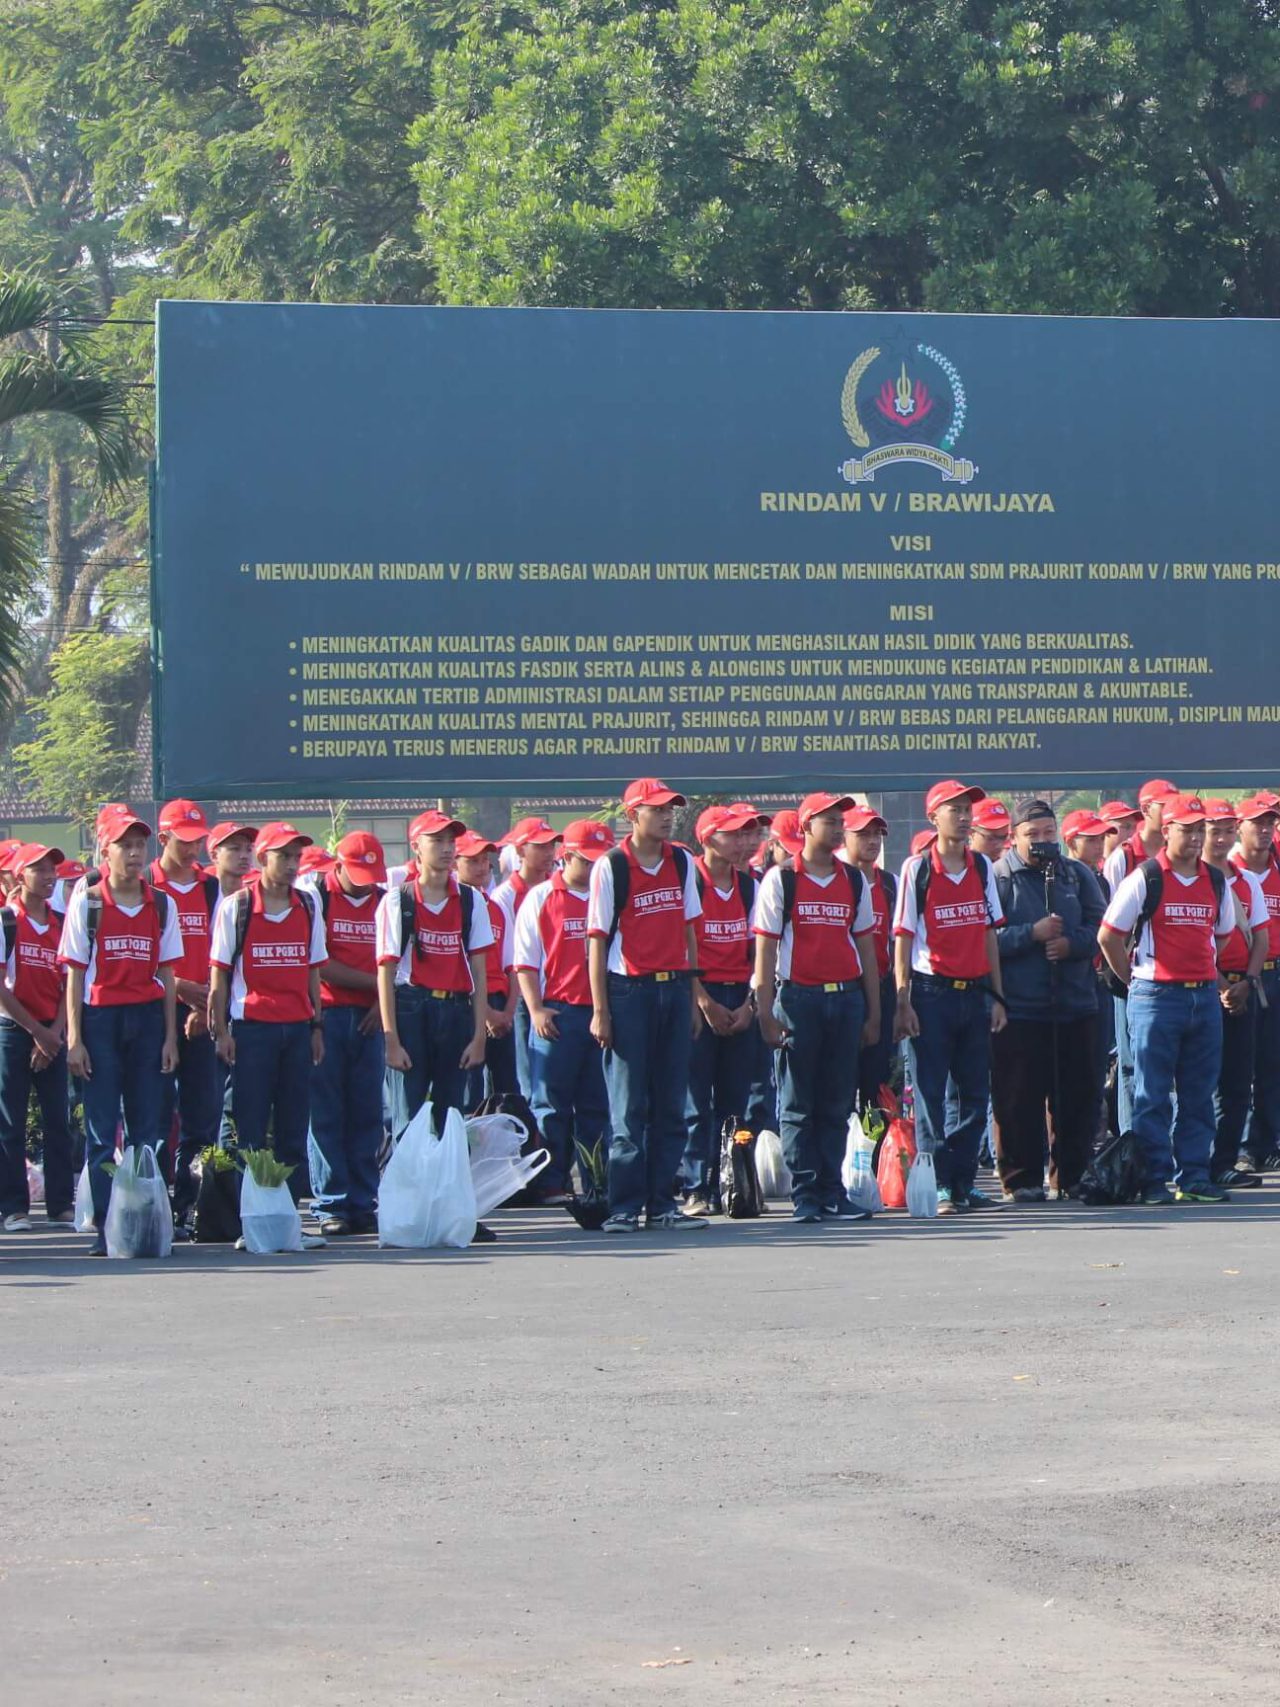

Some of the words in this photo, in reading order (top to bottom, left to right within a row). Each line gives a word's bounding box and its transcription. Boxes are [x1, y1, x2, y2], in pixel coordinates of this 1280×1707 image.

[760, 493, 862, 511] RINDAM
[868, 493, 888, 511] V
[894, 493, 902, 512] /
[908, 493, 1056, 512] BRAWIJAYA
[889, 536, 932, 551] VISI
[255, 563, 374, 580] MEWUJUDKAN
[378, 563, 445, 580] RINDAM
[448, 563, 461, 579] V
[464, 563, 472, 580] /
[475, 563, 515, 579] BRW
[518, 563, 588, 580] SEBAGAI
[591, 564, 651, 580] WADAH
[655, 563, 710, 579] UNTUK
[713, 563, 801, 579] MENCETAK
[805, 563, 838, 579] DAN
[841, 563, 965, 579] MENINGKATKAN
[969, 563, 1005, 579] SDM
[1008, 563, 1085, 579] PRAJURIT
[1088, 564, 1144, 579] KODAM
[1147, 564, 1159, 579] V
[1162, 563, 1169, 579] /
[1172, 564, 1208, 579] BRW
[1211, 564, 1252, 579] YANG
[889, 605, 934, 620] MISI
[302, 636, 433, 653] MENINGKATKAN
[437, 636, 516, 652] KUALITAS
[520, 636, 571, 652] GADIK
[574, 636, 608, 652] DAN
[612, 635, 694, 652] GAPENDIK
[698, 635, 752, 651] UNTUK
[755, 634, 880, 651] MENGHASILKAN
[884, 634, 930, 650] HASIL
[933, 634, 977, 649] DIDIK
[980, 634, 1022, 649] YANG
[1026, 633, 1134, 649] BERKUALITAS.
[302, 662, 433, 679] MENINGKATKAN
[437, 662, 516, 678] KUALITAS
[520, 662, 579, 677] FASDIK
[584, 661, 635, 677] SERTA
[638, 661, 686, 677] ALINS
[690, 661, 703, 677] &
[707, 660, 786, 676] ALONGINS
[790, 660, 843, 675] UNTUK
[847, 659, 947, 675] MENDUKUNG
[951, 659, 1027, 674] KEGIATAN
[1031, 658, 1124, 674] PENDIDIKAN
[1128, 658, 1140, 673] &
[1144, 658, 1214, 673] LATIHAN.
[302, 688, 418, 705] MENEGAKKAN
[421, 688, 480, 704] TERTIB
[484, 687, 602, 703] ADMINISTRASI
[606, 687, 664, 703] DALAM
[668, 686, 725, 702] SETIAP
[730, 685, 837, 701] PENGGUNAAN
[841, 685, 927, 700] ANGGARAN
[930, 684, 973, 699] YANG
[976, 683, 1078, 699] TRANSPARAN
[1083, 683, 1095, 698] &
[1099, 682, 1194, 698] AKUNTABLE.
[302, 714, 433, 731] MENINGKATKAN
[438, 713, 516, 730] KUALITAS
[521, 713, 588, 729] MENTAL
[592, 712, 676, 730] PRAJURIT,
[681, 711, 761, 727] SEHINGGA
[765, 710, 829, 726] RINDAM
[832, 710, 845, 725] V
[848, 710, 855, 725] /
[859, 710, 896, 725] BRW
[900, 709, 951, 725] BEBAS
[955, 709, 992, 724] DARI
[996, 708, 1108, 724] PELANGGARAN
[1112, 707, 1174, 725] HUKUM,
[1178, 707, 1243, 722] DISIPLIN
[302, 740, 388, 757] BERUPAYA
[392, 740, 445, 756] TERUS
[449, 739, 529, 755] MENERUS
[532, 738, 578, 755] AGAR
[582, 738, 662, 754] PRAJURIT
[666, 737, 730, 753] RINDAM
[734, 737, 747, 752] V
[750, 736, 757, 752] /
[760, 736, 798, 752] BRW
[802, 735, 901, 751] SENANTIASA
[904, 734, 972, 750] DICINTAI
[976, 733, 1042, 749] RAKYAT.
[675, 889, 682, 901] 3
[798, 904, 820, 916] SMK
[935, 907, 957, 920] SMK
[1164, 906, 1185, 917] SMK
[333, 921, 354, 934] SMK
[563, 920, 585, 932] SMK
[104, 939, 128, 951] SMK
[252, 946, 274, 958] SMK
[276, 946, 299, 958] PGRI
[299, 945, 306, 957] 3
